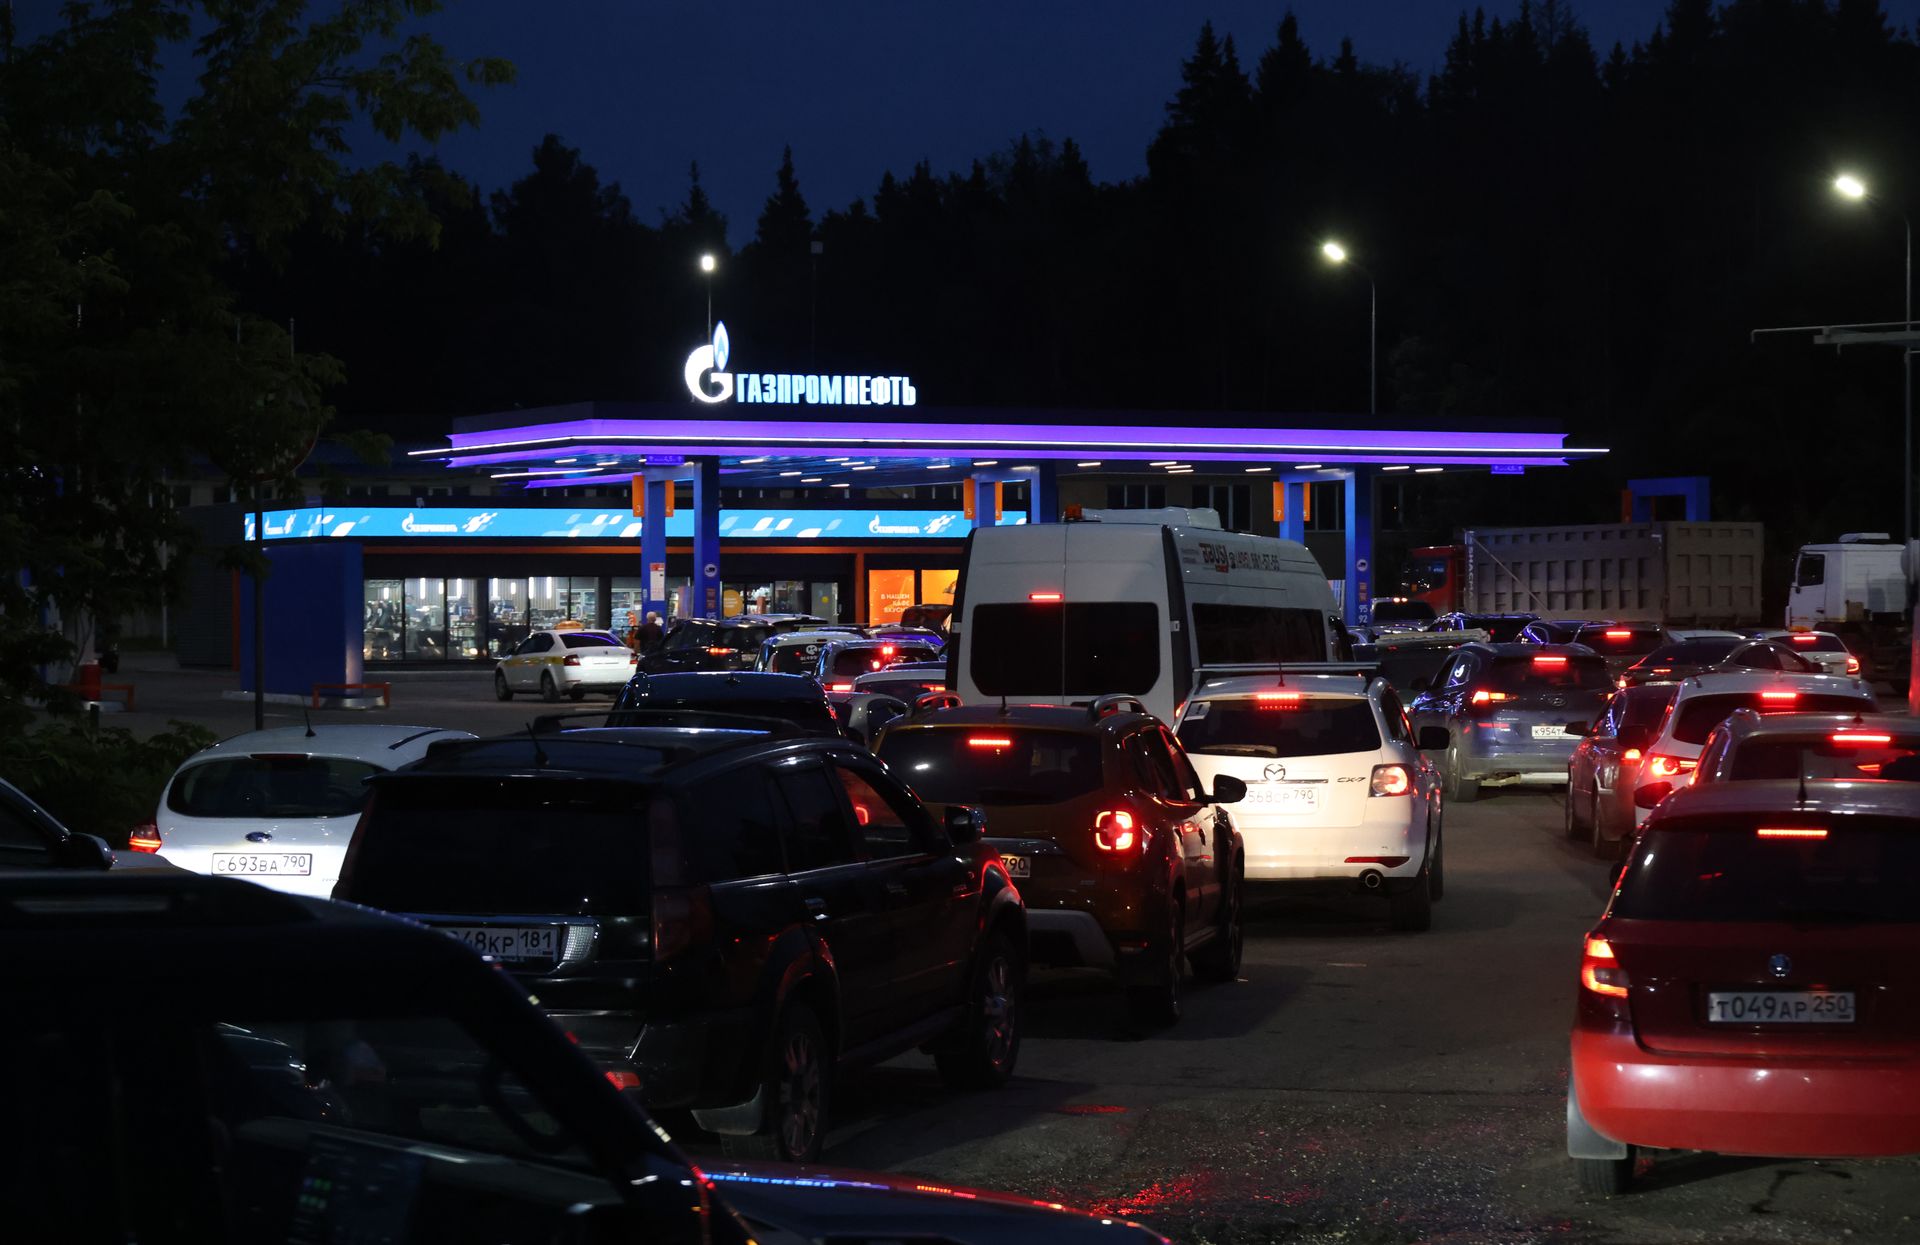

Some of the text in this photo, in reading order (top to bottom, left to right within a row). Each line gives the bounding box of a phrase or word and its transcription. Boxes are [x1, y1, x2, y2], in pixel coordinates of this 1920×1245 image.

[1358, 614, 1368, 623] 92
[1293, 789, 1314, 800] 790
[217, 855, 306, 872] С693ВА 790
[520, 930, 551, 948] 181
[1717, 995, 1848, 1018] Т049АР 250
